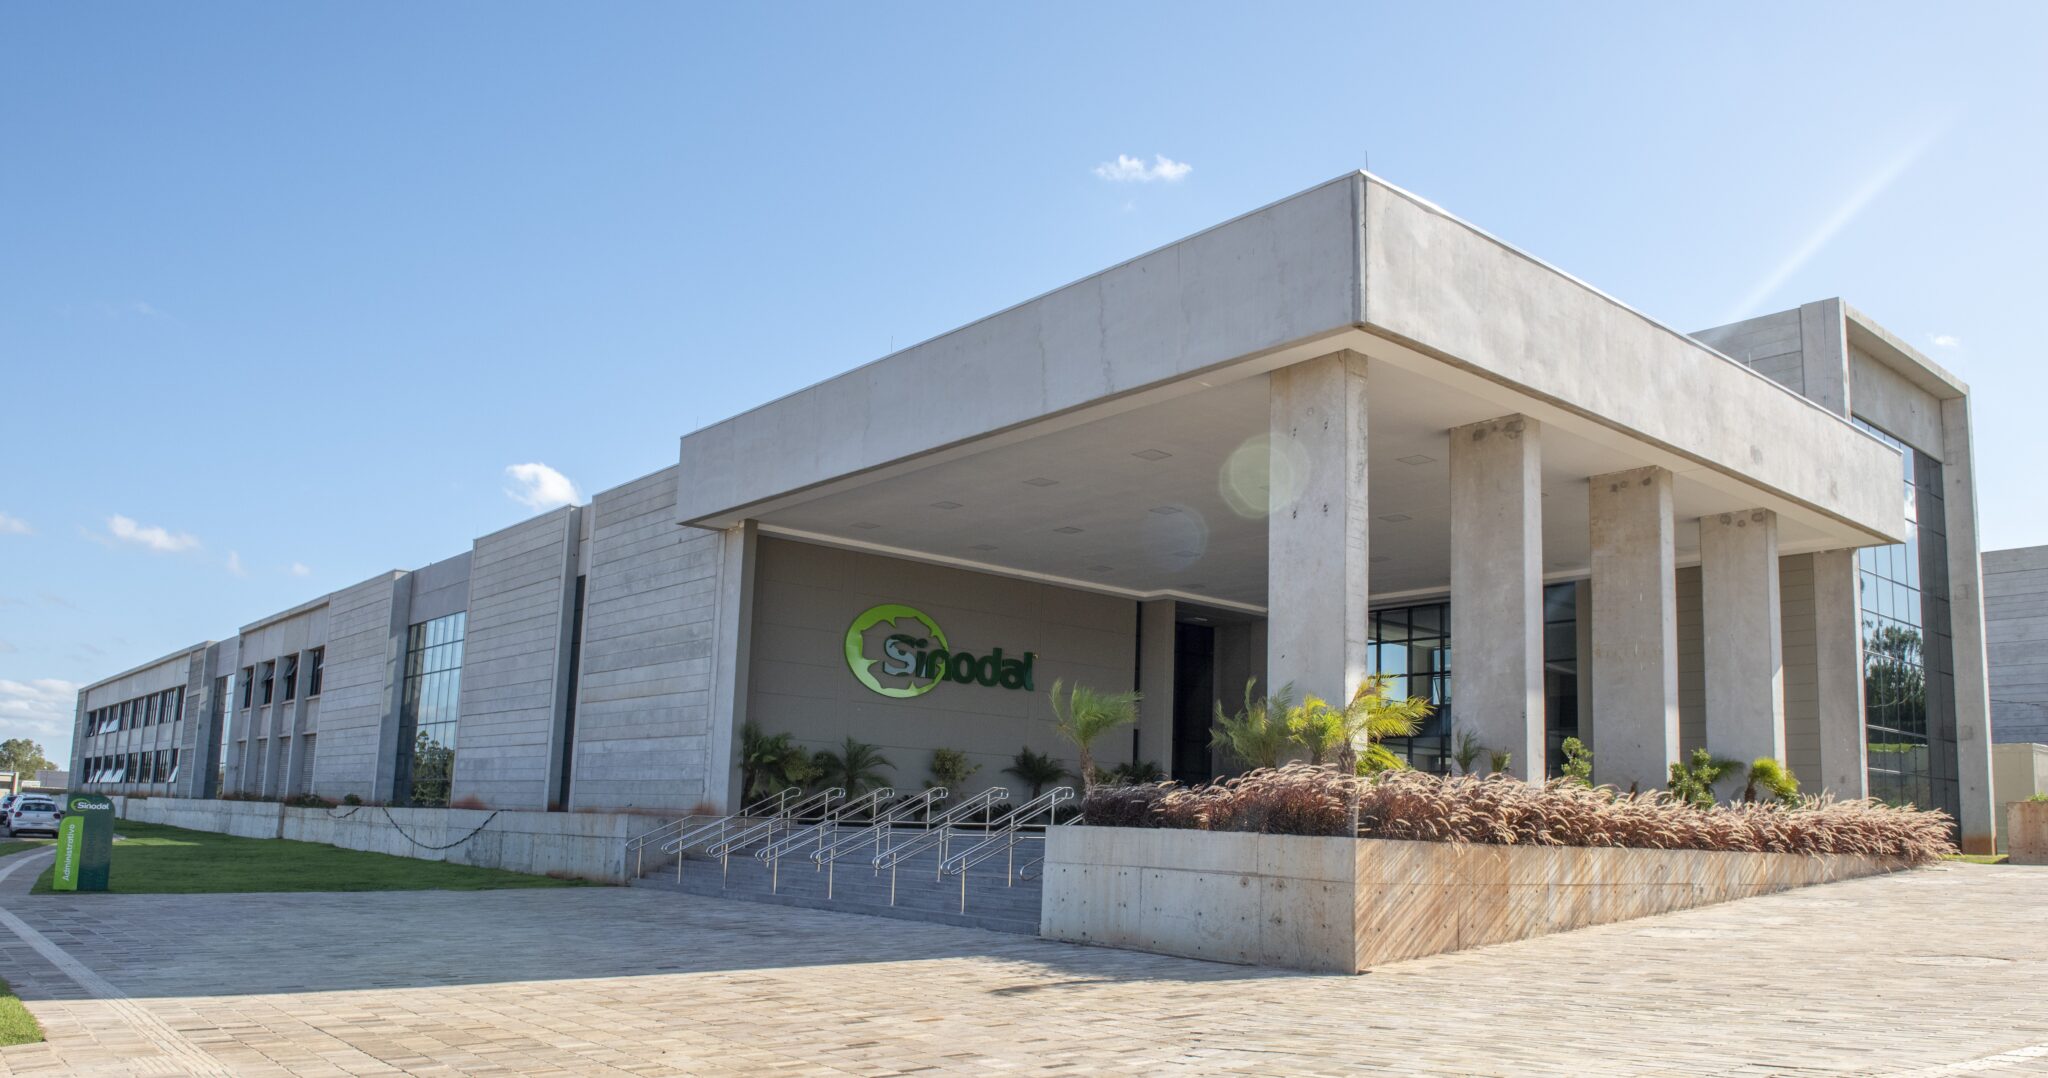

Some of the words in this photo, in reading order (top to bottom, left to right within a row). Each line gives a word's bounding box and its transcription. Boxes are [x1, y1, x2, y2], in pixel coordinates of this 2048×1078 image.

[883, 634, 1034, 691] Sinodal
[77, 802, 109, 810] Sinodal
[63, 824, 75, 881] Administrativo
